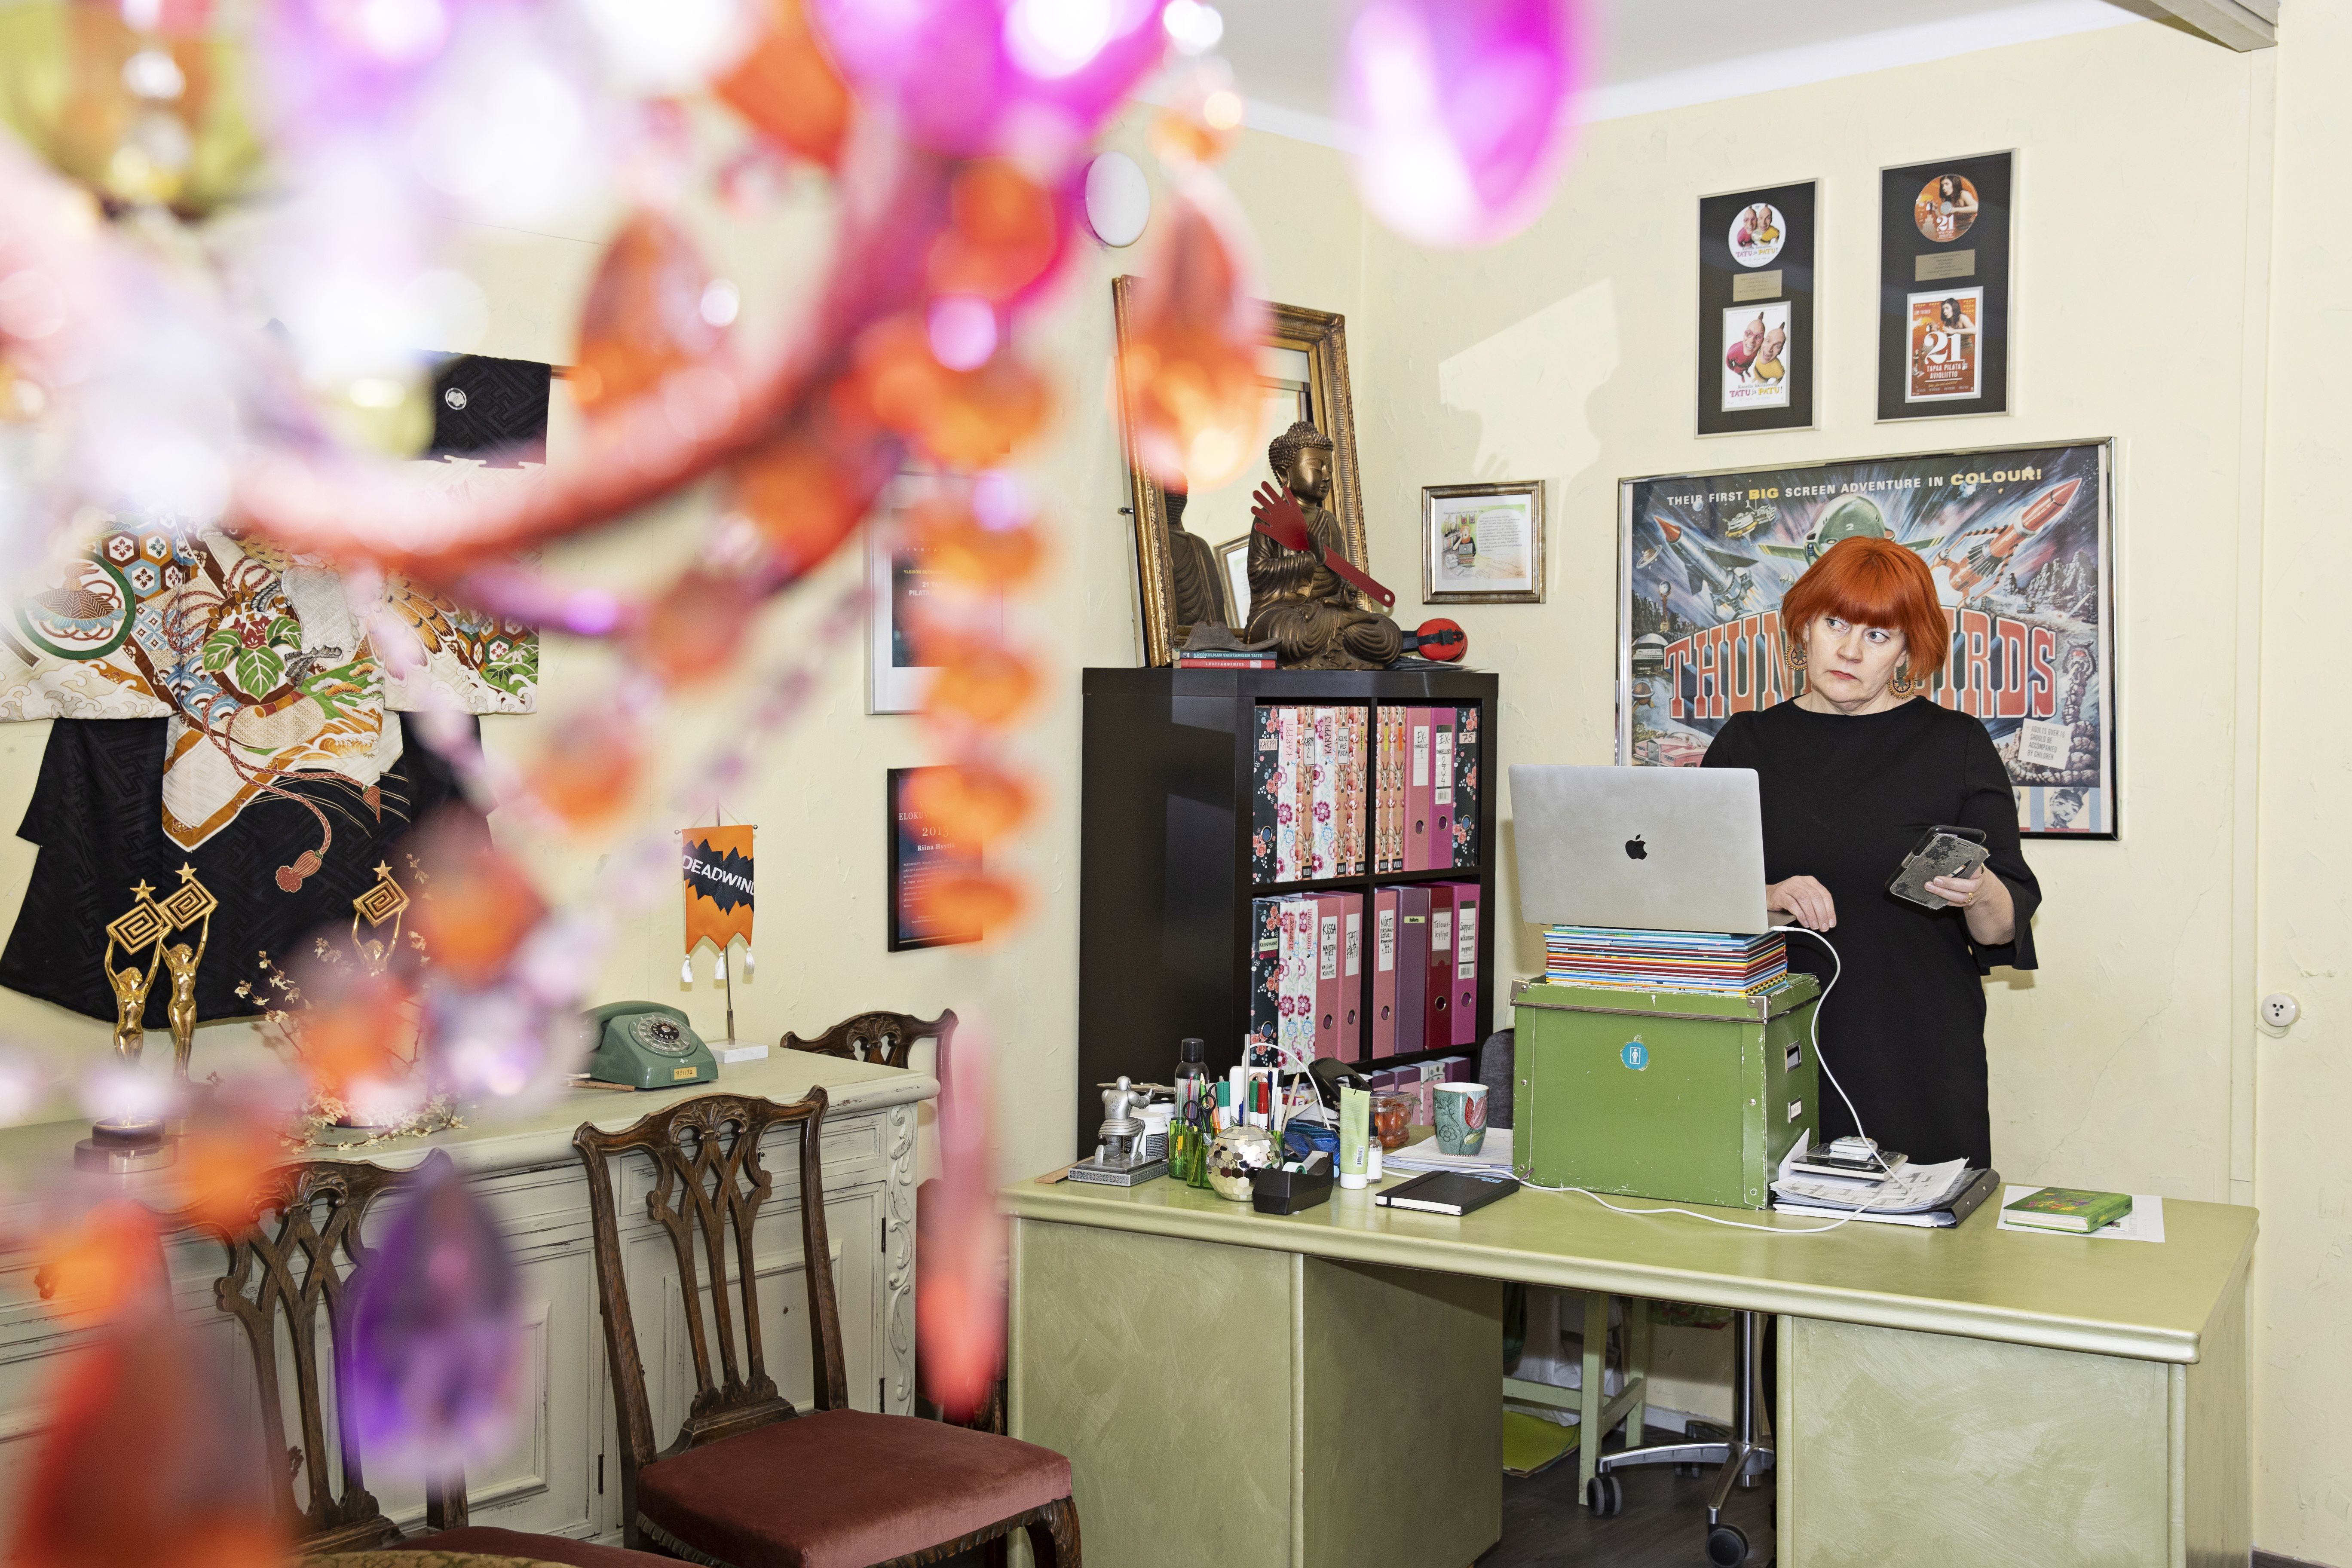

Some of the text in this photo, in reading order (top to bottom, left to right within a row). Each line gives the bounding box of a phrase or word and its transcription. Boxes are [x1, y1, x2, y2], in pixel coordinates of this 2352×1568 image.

[1936, 214, 1956, 232] 21
[1923, 331, 1965, 364] 21
[1667, 469, 2041, 506] THEIR FIRST BIG SCREEN ADVENTURE IN COLOUR!
[2031, 726, 2047, 734] ADULTS
[2048, 729, 2059, 737] OVER
[1417, 731, 1426, 744] EX-
[1439, 734, 1451, 744] EX-
[1462, 733, 1474, 743] 75
[2030, 733, 2046, 742] SHOULD
[1260, 740, 1276, 749] KARPPI
[2029, 741, 2058, 753] ACCOMPANIED
[1307, 747, 1311, 758] 2
[1420, 749, 1424, 759] 1
[2034, 750, 2054, 760] CHILDREN
[1442, 756, 1446, 766] 2
[1441, 766, 1446, 776] 3
[1441, 776, 1446, 787] 4
[922, 826, 949, 837] 2013
[1433, 920, 1450, 929] Talous-
